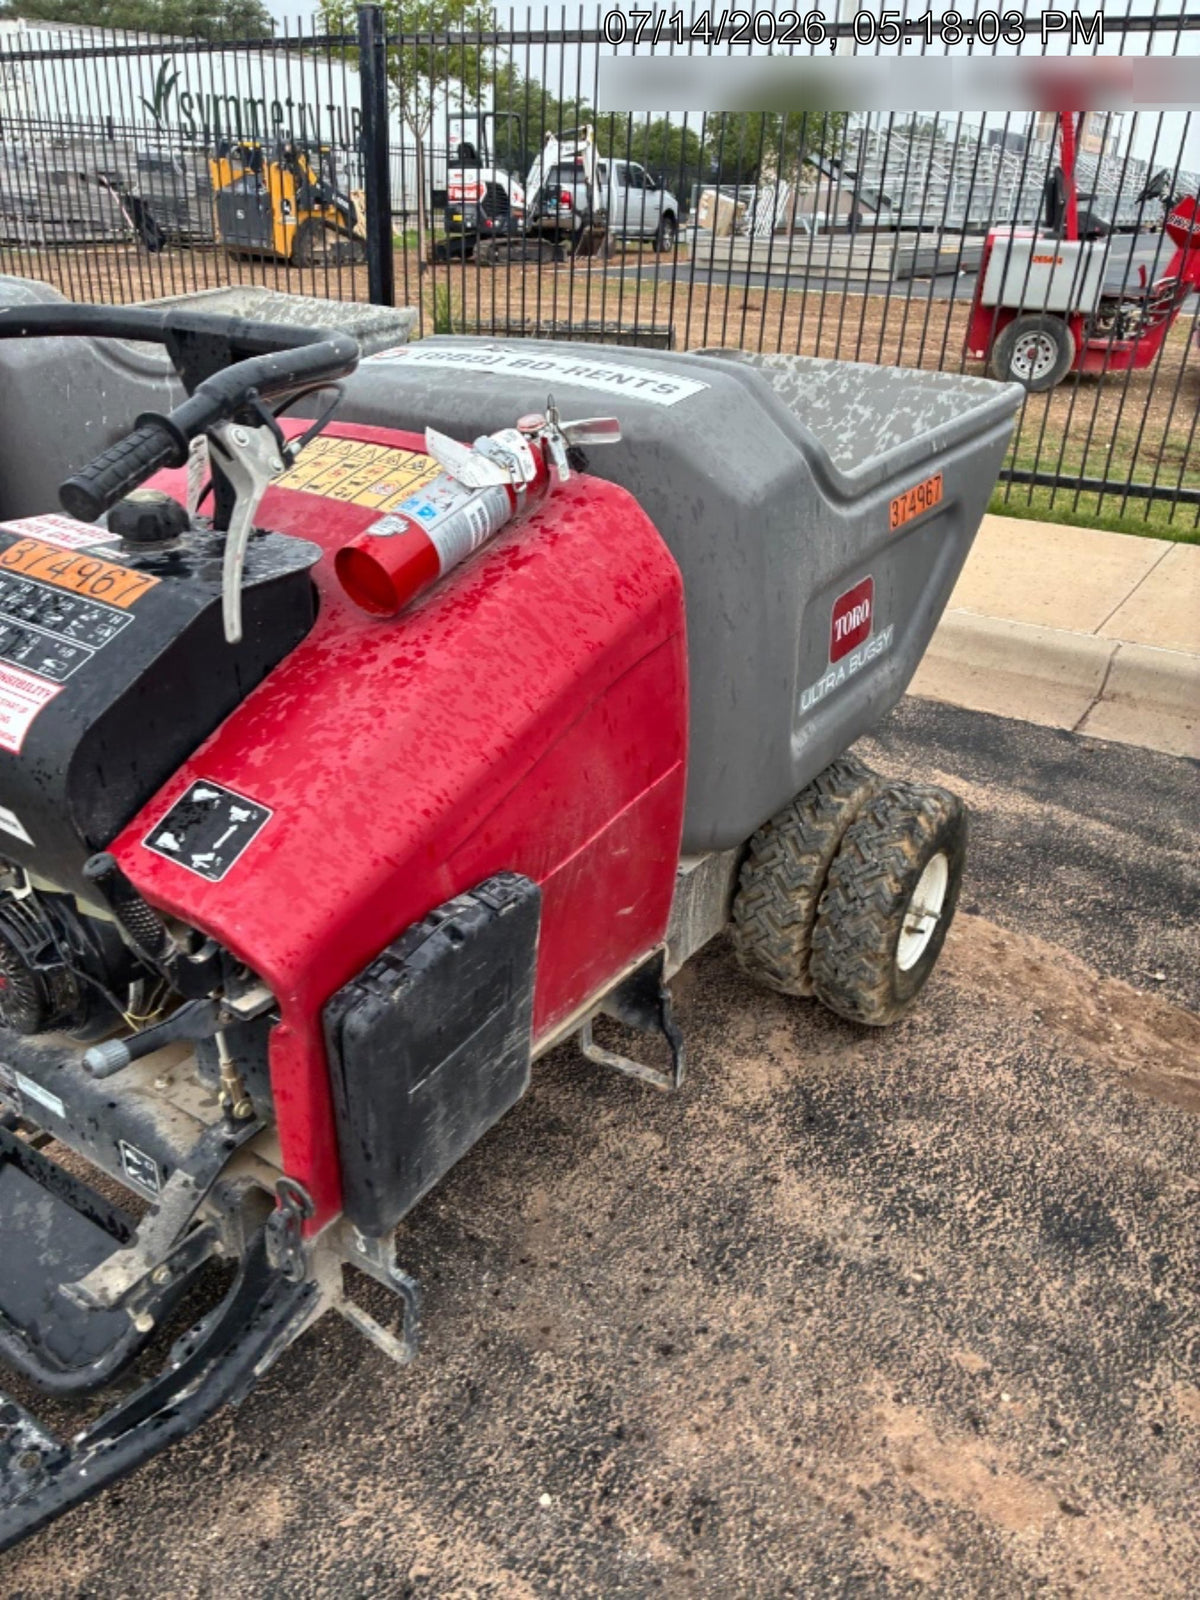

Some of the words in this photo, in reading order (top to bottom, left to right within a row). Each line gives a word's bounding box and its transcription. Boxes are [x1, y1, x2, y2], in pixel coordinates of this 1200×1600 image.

[326, 104, 362, 150] TUR
[891, 475, 943, 527] 374967
[1, 540, 153, 602] 374967
[834, 598, 870, 642] TORO
[801, 668, 846, 711] ULTRA
[848, 626, 894, 672] BUGGY
